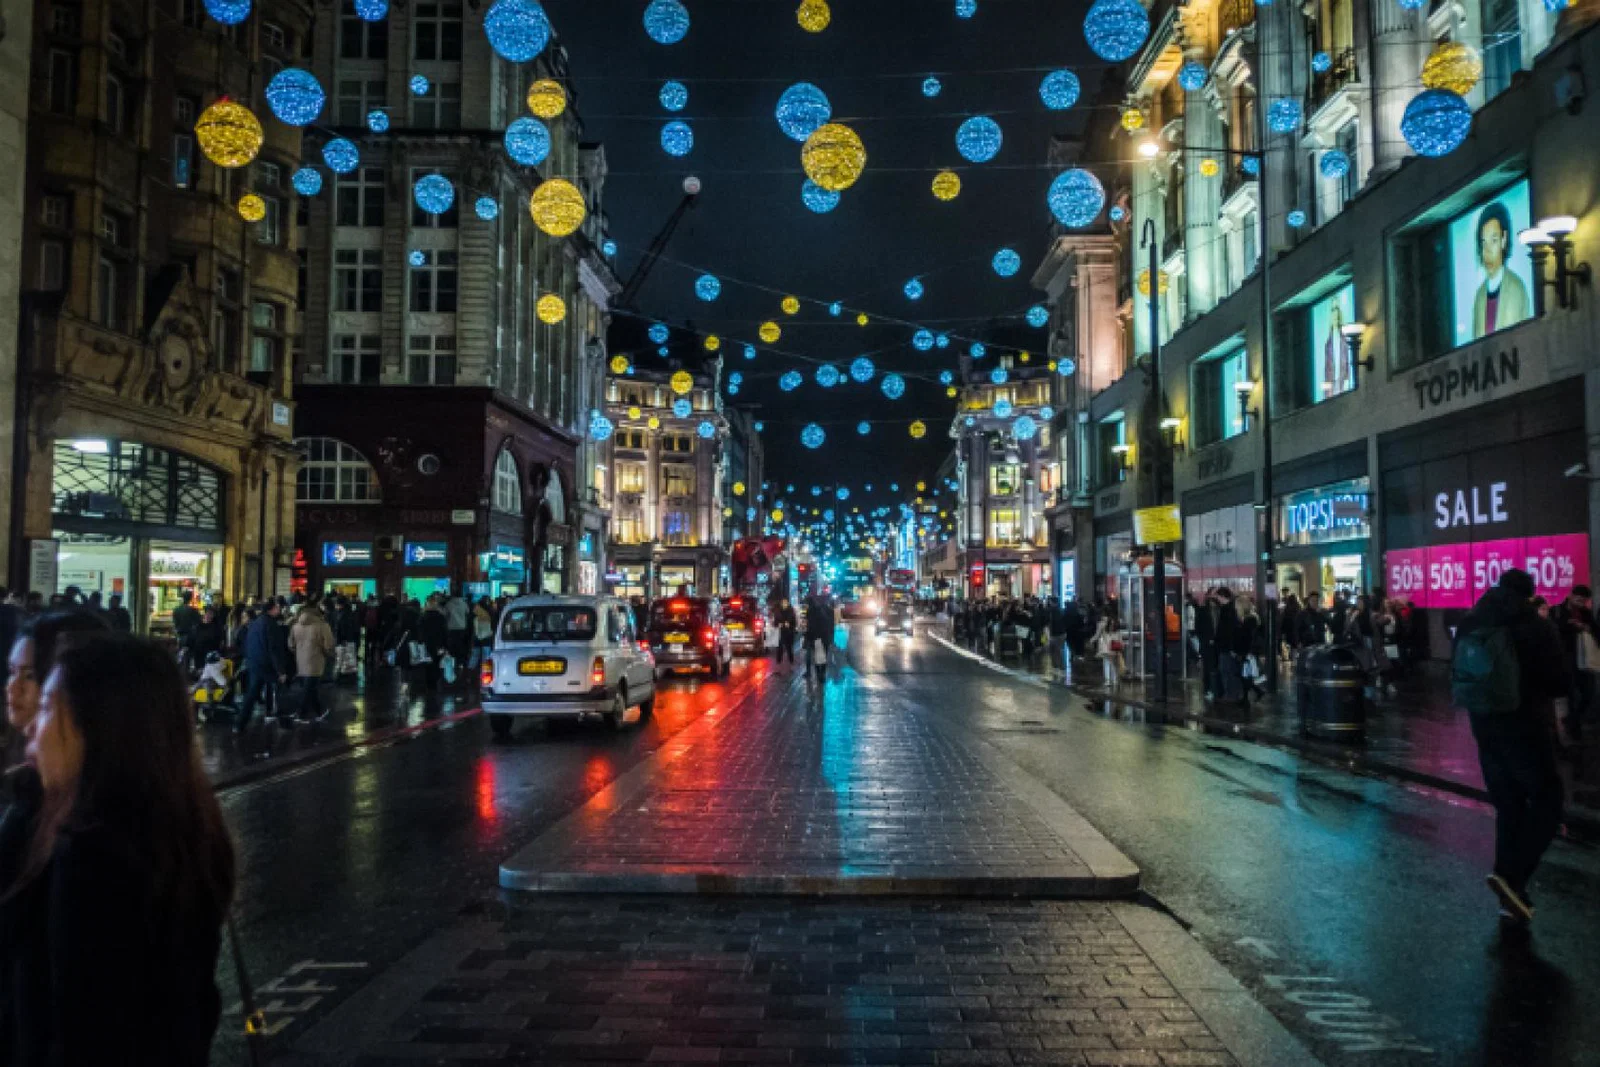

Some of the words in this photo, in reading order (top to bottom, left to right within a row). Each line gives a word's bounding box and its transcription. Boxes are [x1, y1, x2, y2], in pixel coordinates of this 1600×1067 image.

[1414, 347, 1519, 410] TOPMAN
[1434, 481, 1509, 529] SALE
[1431, 562, 1466, 590] 50%
[1525, 555, 1575, 587] 50%
